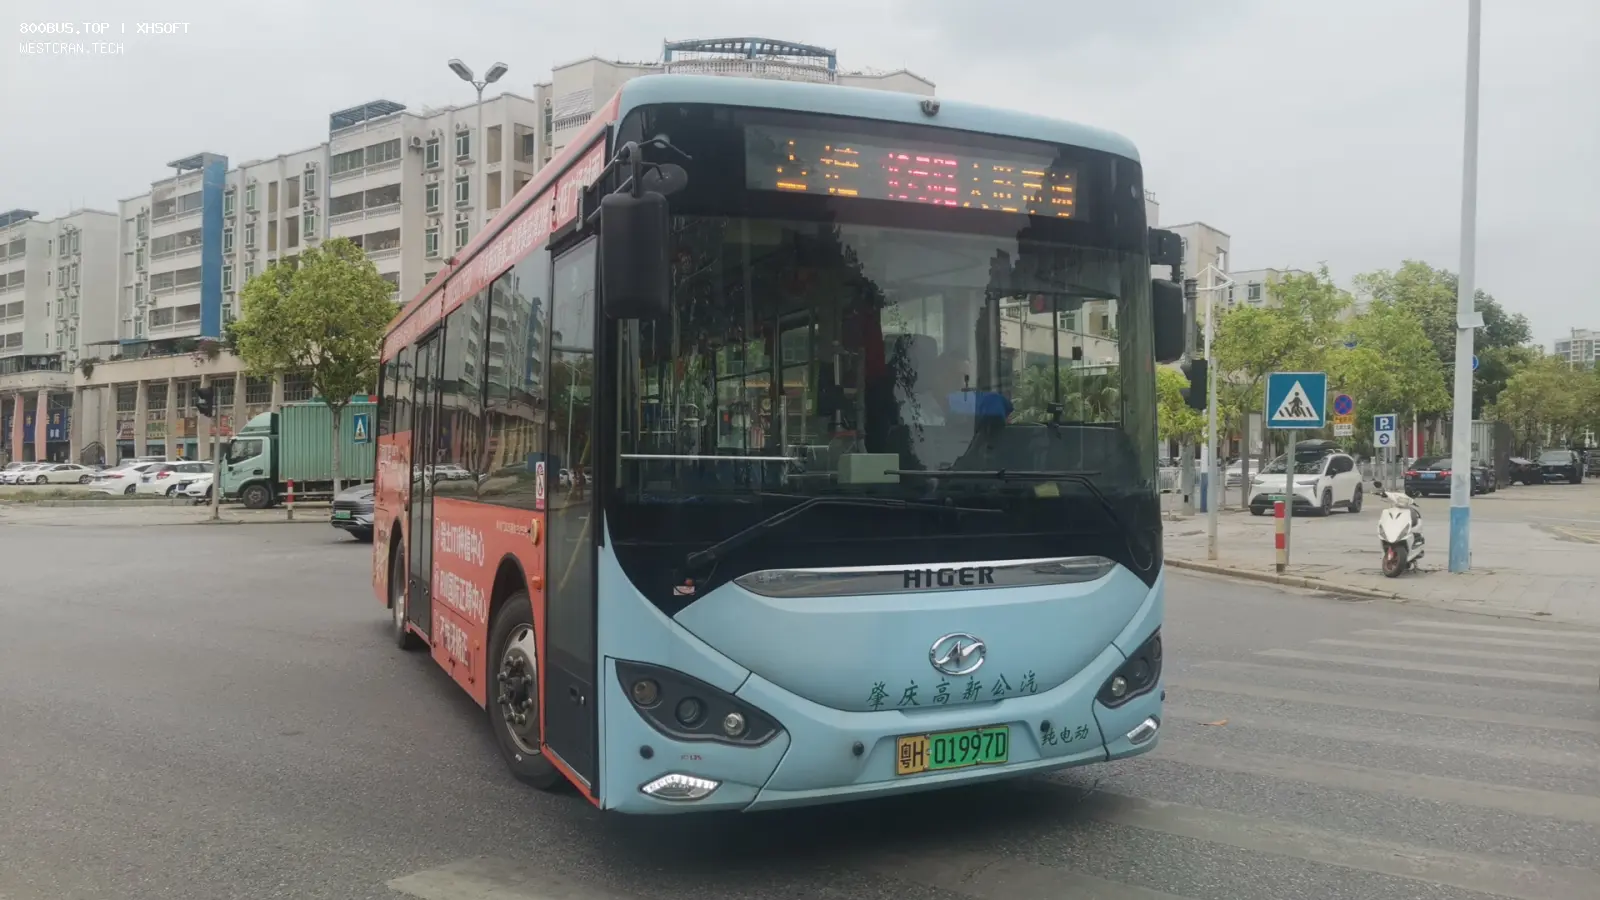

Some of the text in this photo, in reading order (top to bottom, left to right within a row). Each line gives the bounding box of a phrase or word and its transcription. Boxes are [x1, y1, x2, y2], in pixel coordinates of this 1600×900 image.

[903, 567, 994, 588] HIGER
[866, 669, 1038, 711] 肇庆高新公汽
